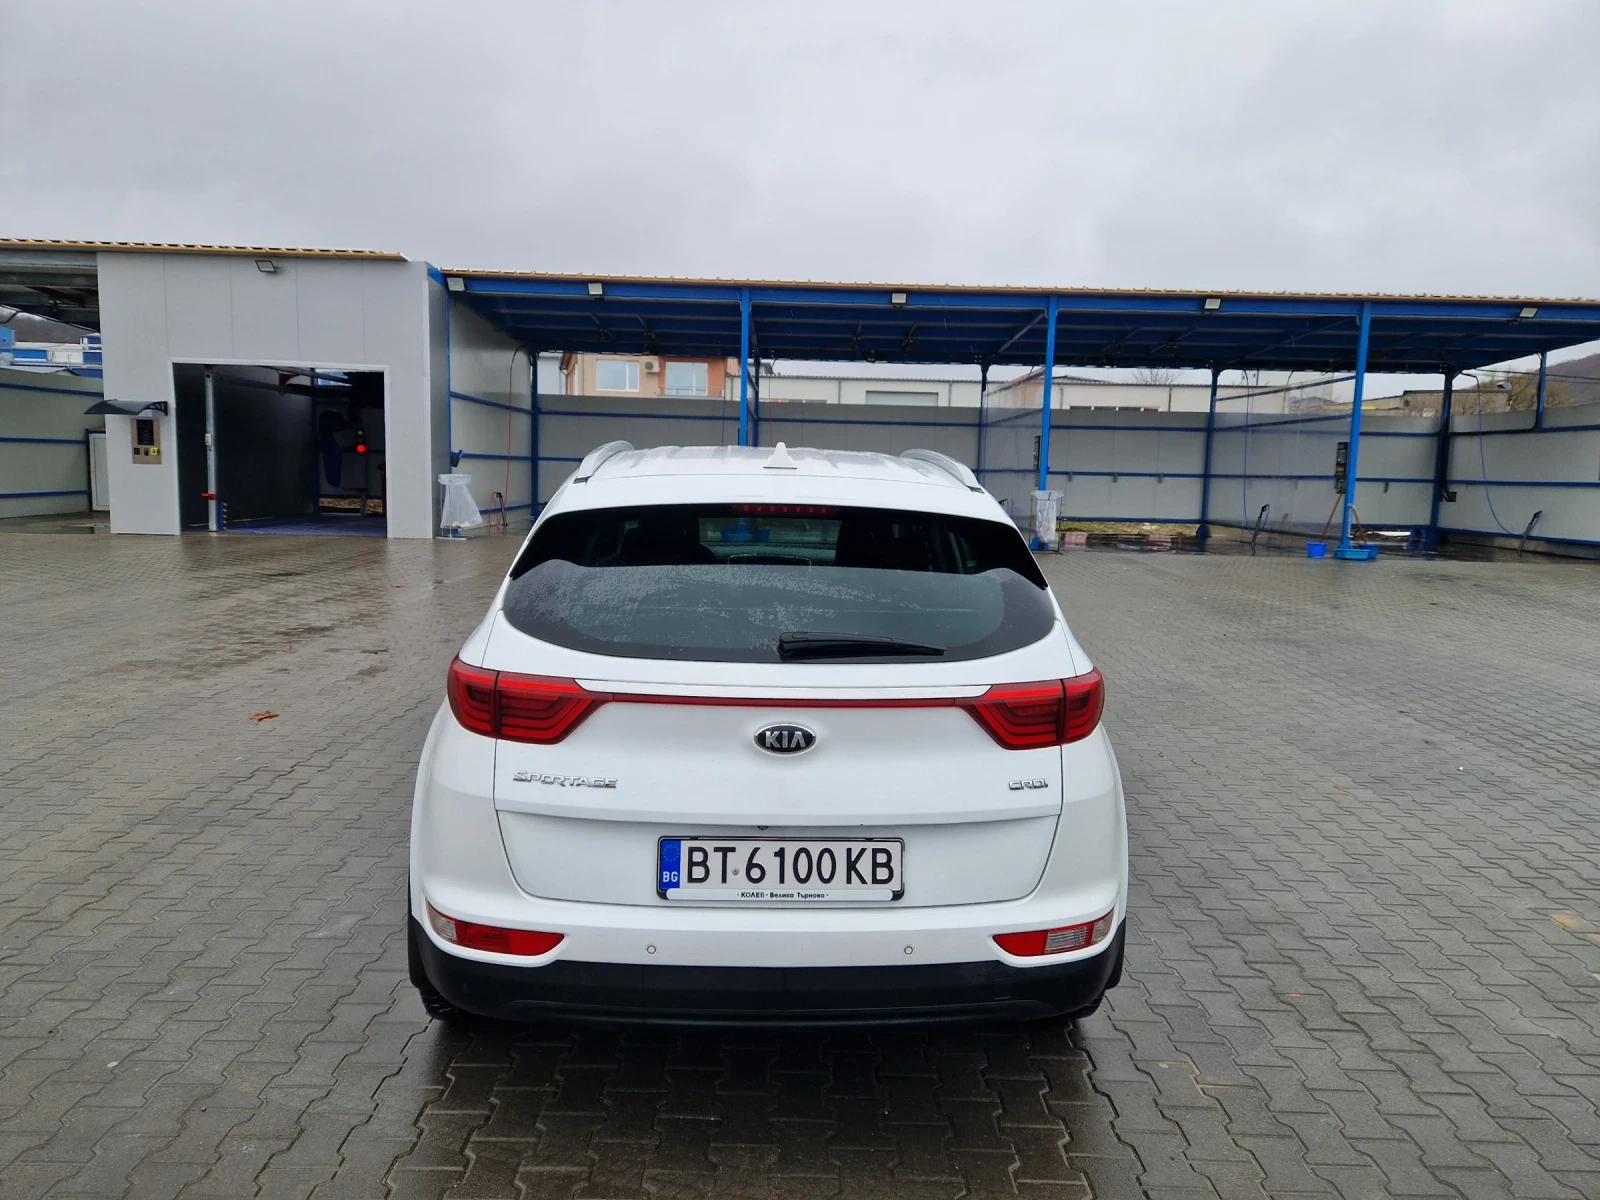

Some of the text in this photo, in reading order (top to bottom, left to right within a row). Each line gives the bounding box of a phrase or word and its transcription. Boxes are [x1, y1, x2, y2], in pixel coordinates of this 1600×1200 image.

[765, 730, 806, 748] KIA
[513, 770, 618, 788] SPORTAGE
[662, 871, 678, 883] BG
[769, 891, 795, 899] Велико
[796, 891, 825, 900] Търново
